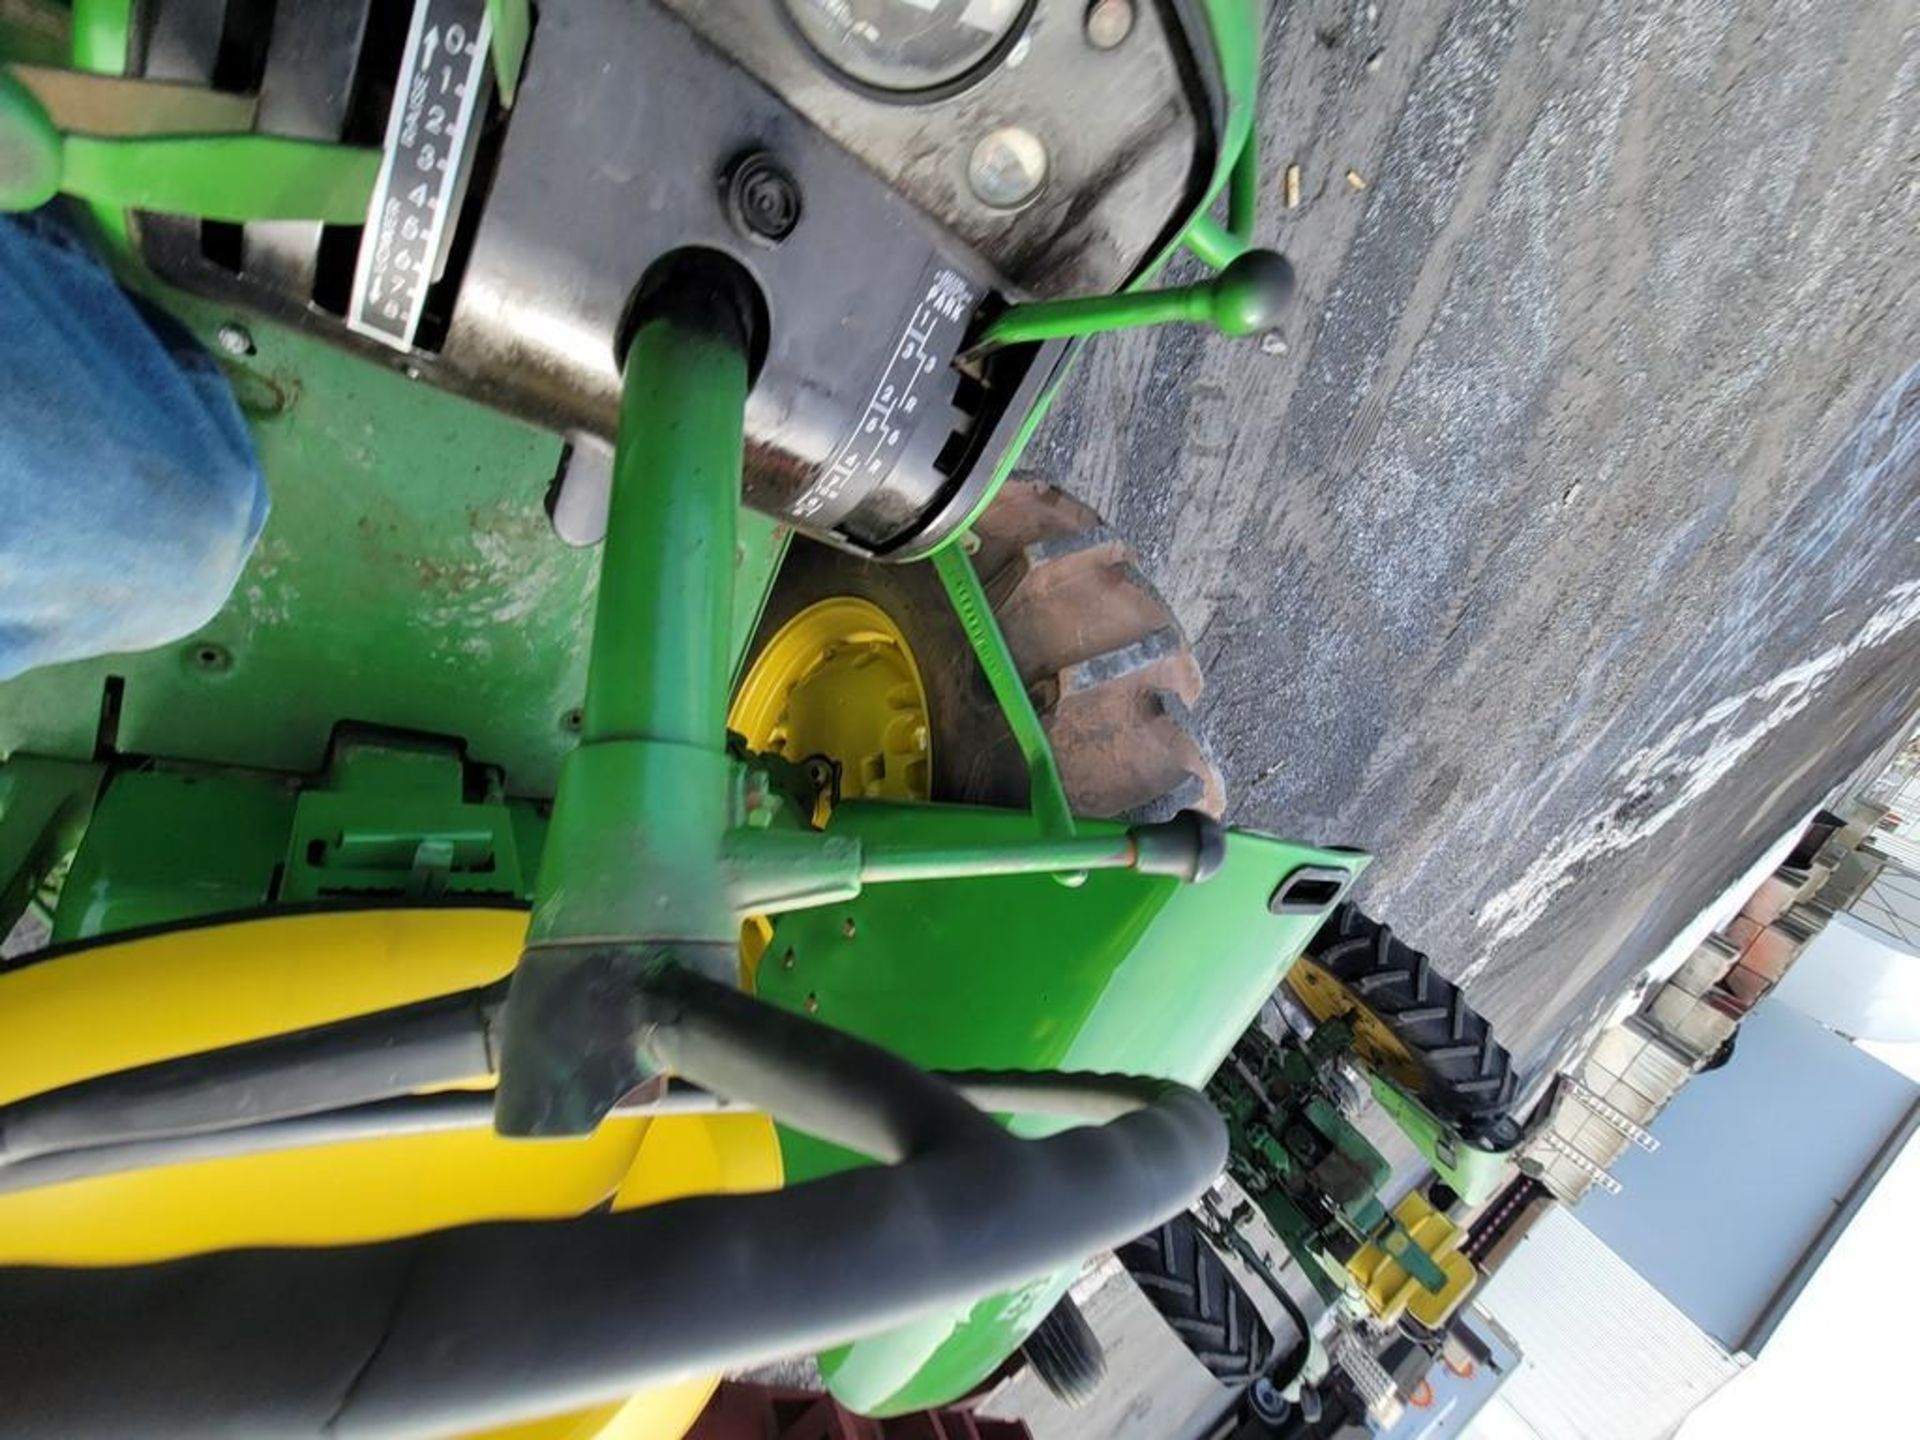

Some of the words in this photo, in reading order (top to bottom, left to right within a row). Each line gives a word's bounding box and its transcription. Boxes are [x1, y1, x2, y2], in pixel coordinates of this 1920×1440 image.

[444, 23, 466, 55] 0
[440, 66, 452, 94] 1
[425, 104, 446, 135] 2
[416, 143, 436, 172] 3
[407, 183, 428, 208] 4
[394, 249, 412, 271] 6
[390, 274, 406, 294] 7
[925, 284, 966, 323] PARK
[920, 309, 931, 328] 1
[881, 384, 895, 403] 2
